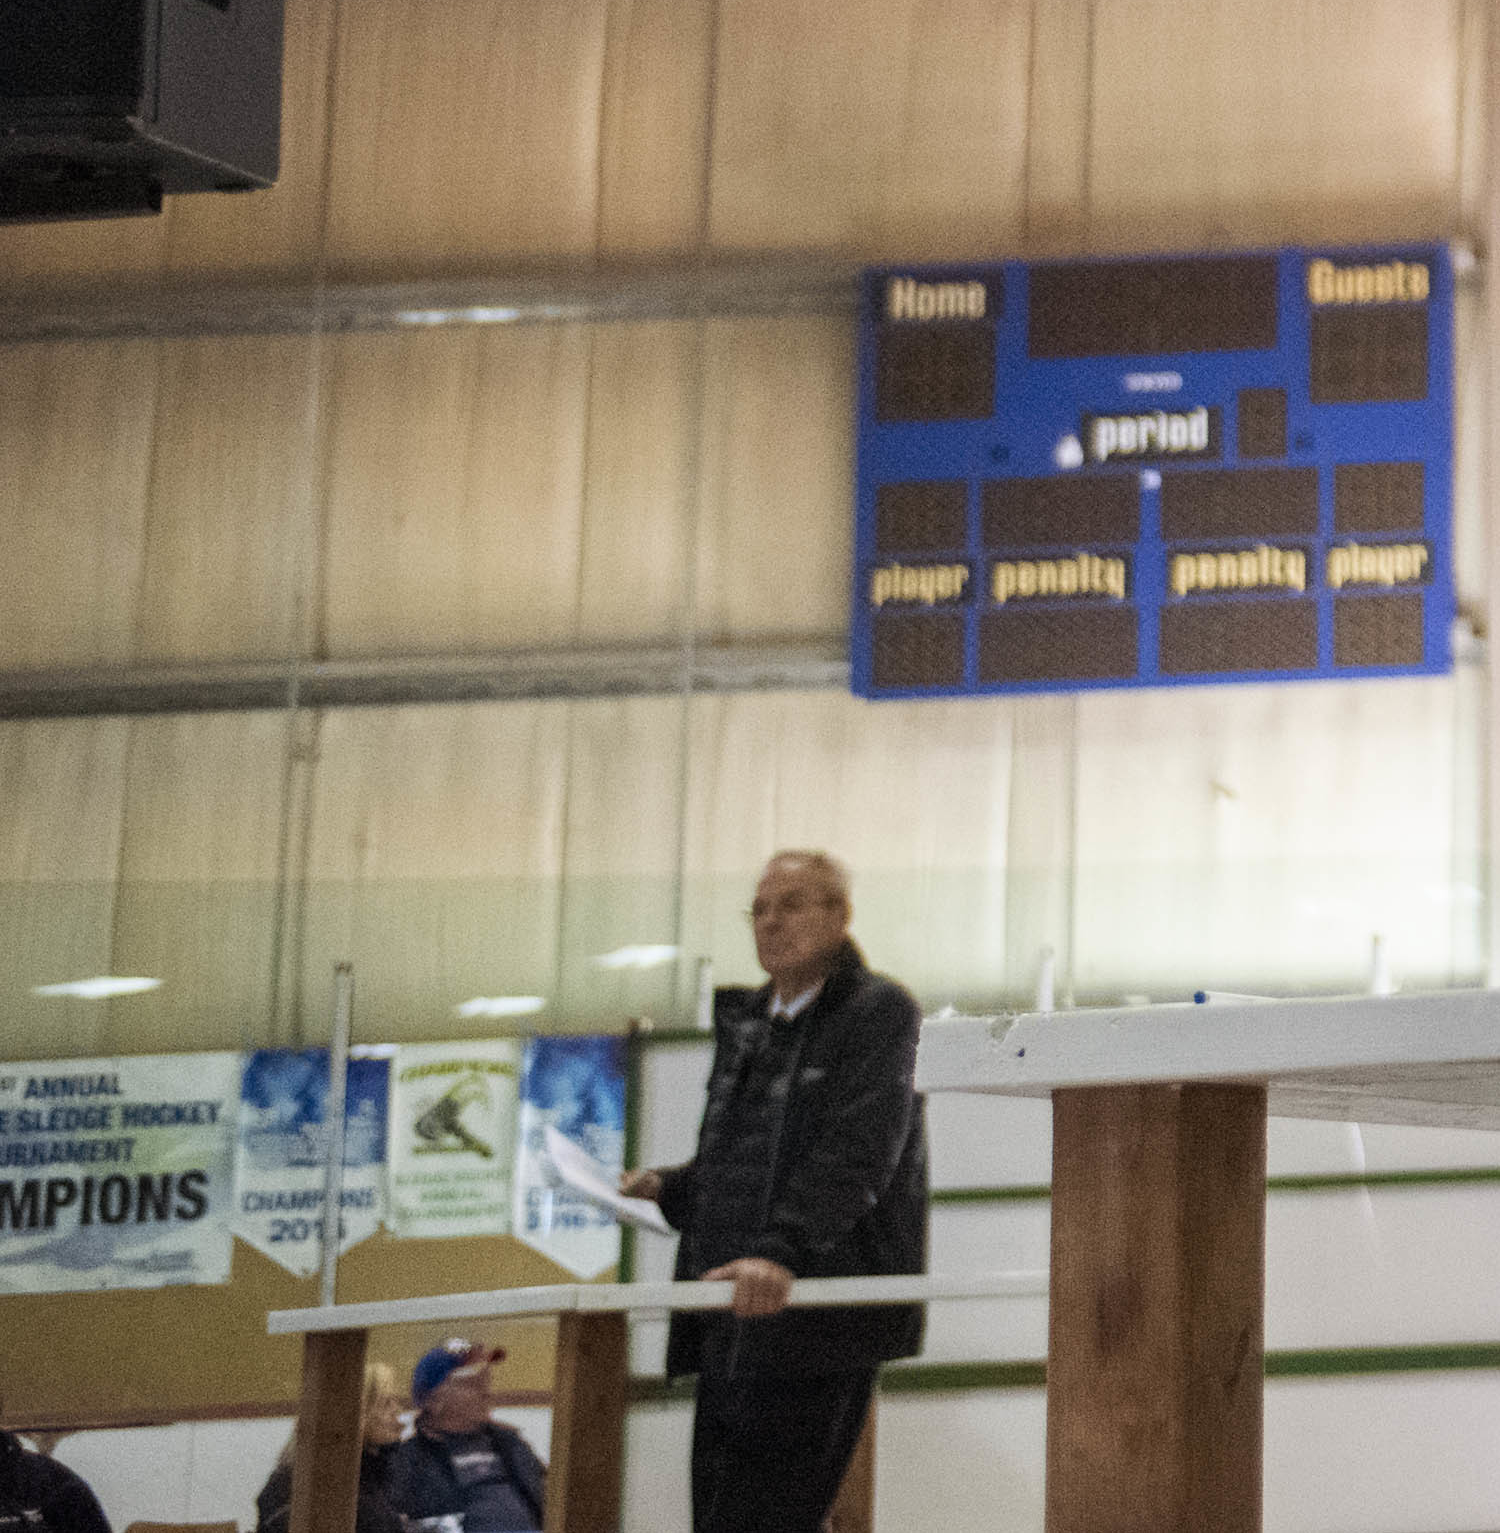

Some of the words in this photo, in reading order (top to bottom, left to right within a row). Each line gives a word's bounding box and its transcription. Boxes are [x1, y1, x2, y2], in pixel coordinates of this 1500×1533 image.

[889, 278, 986, 320] Home
[1092, 406, 1208, 462] period
[872, 563, 969, 606] player
[993, 553, 1125, 603] penalty
[1172, 544, 1305, 596] penalty
[1327, 541, 1427, 589] player
[25, 1073, 120, 1099] ANNUAL
[17, 1103, 113, 1134] SLEDGE
[121, 1100, 221, 1127] HOCKEY
[243, 1187, 374, 1212] CHAMPNS
